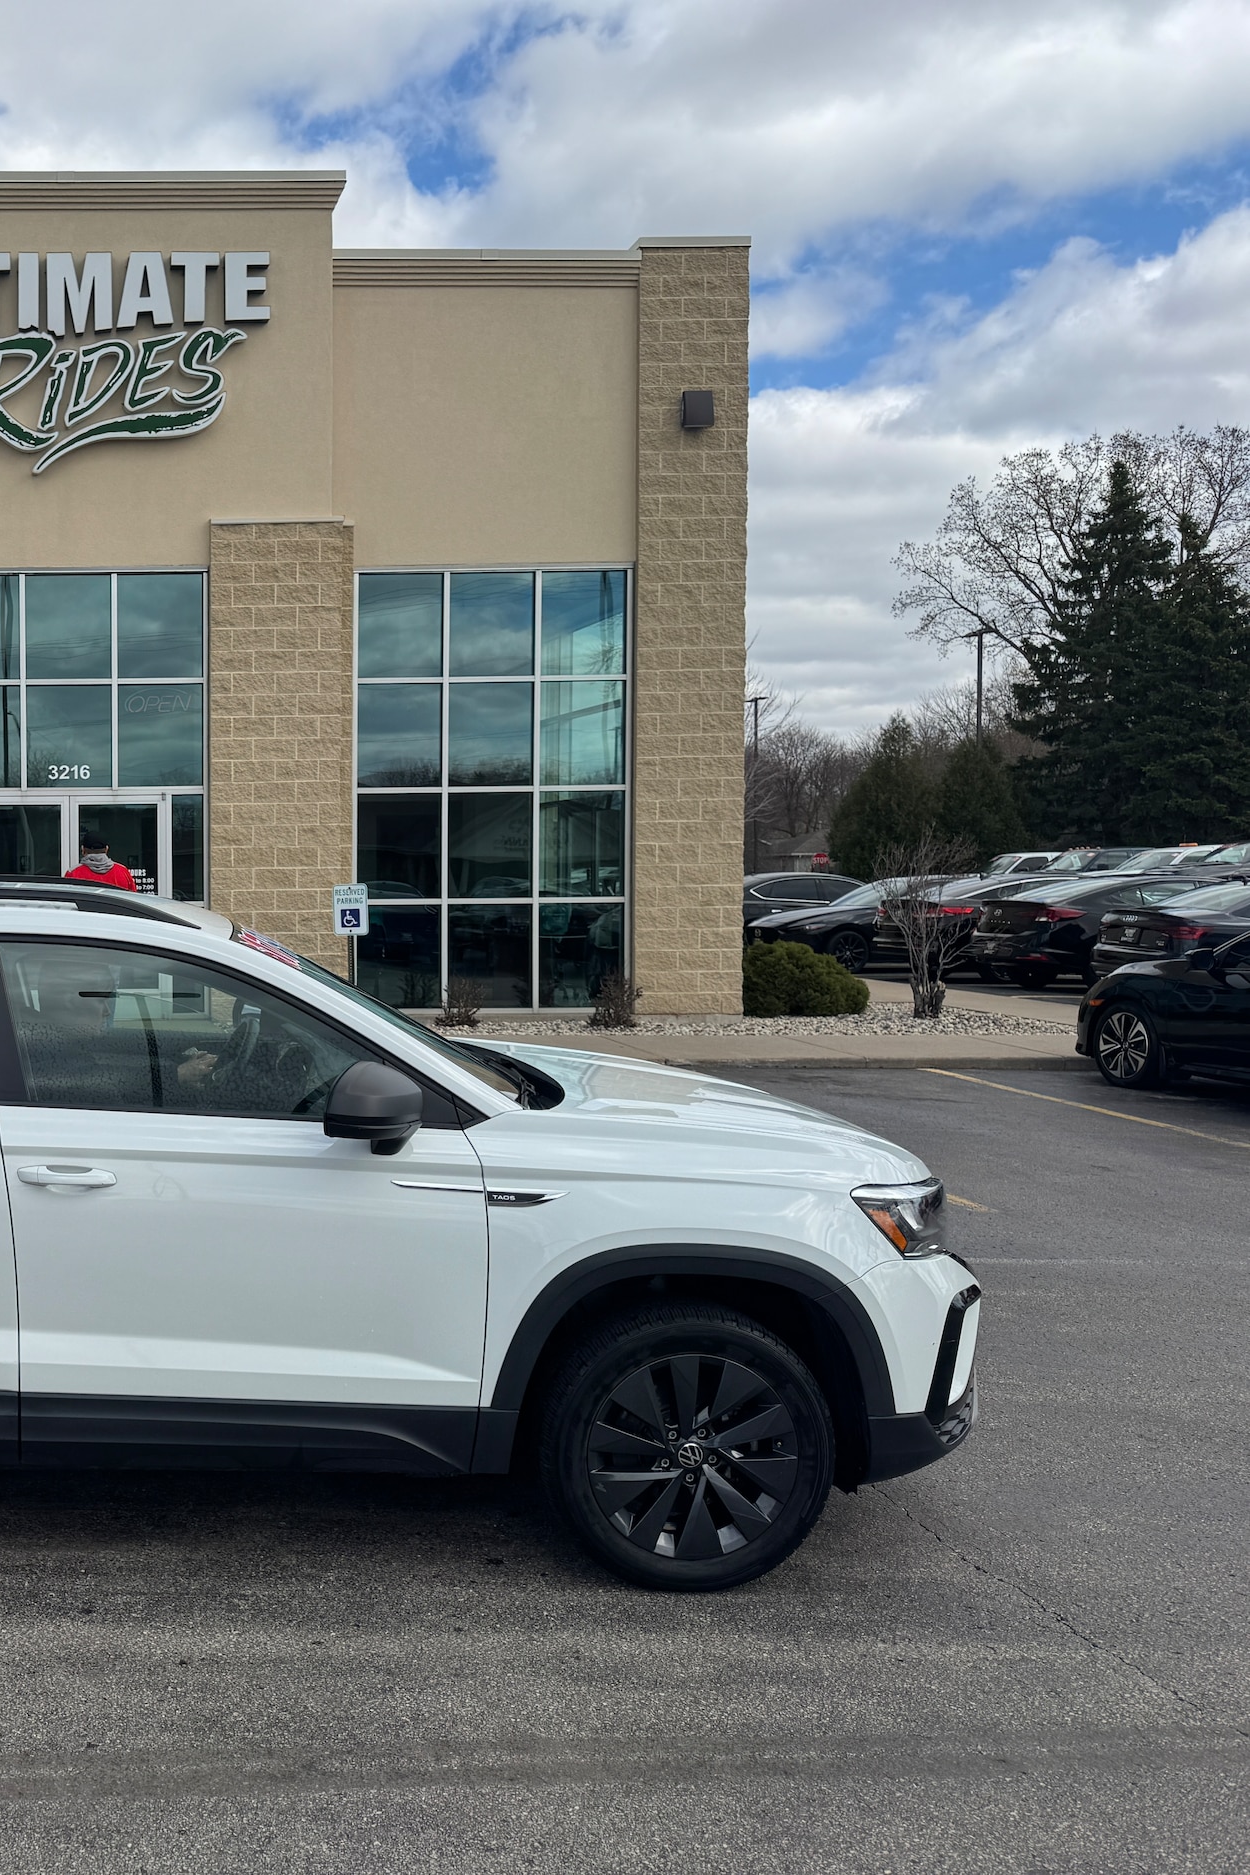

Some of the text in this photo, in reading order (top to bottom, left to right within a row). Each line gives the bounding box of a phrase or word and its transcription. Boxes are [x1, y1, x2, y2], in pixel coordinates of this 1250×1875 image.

[127, 695, 192, 713] OPEN
[47, 764, 91, 781] 3216
[813, 856, 829, 865] STOP
[335, 888, 365, 896] RESERVED
